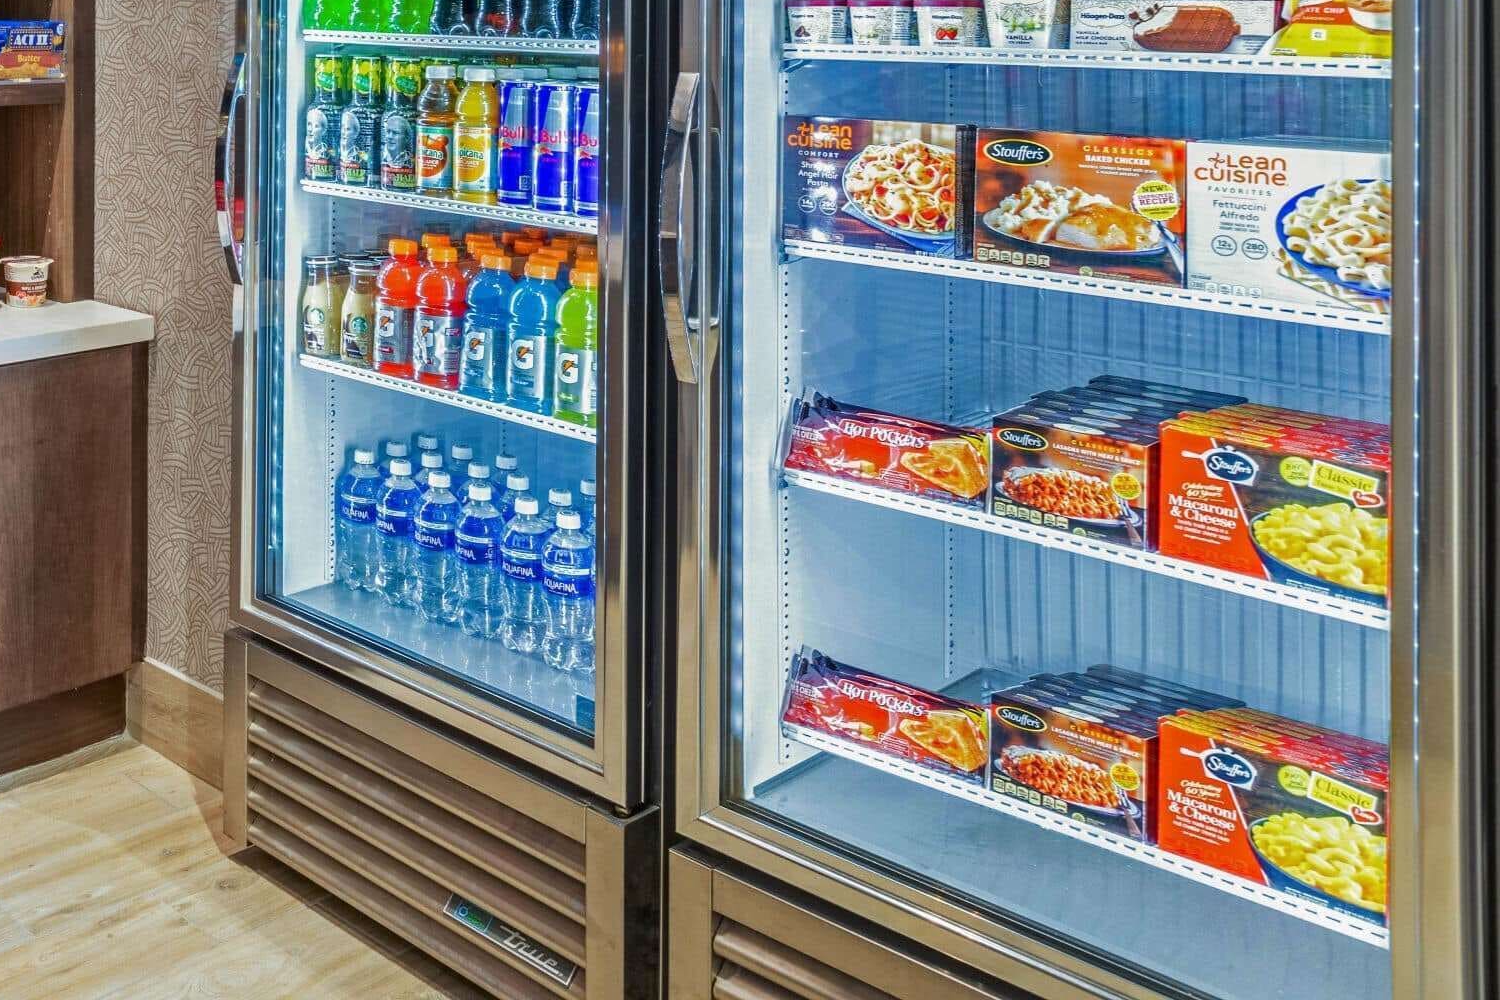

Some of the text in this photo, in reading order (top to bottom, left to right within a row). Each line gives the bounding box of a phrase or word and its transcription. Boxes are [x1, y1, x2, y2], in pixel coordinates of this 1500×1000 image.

[1323, 6, 1346, 16] CHIP
[13, 34, 32, 46] ACT
[1005, 34, 1034, 42] VANILLA
[17, 54, 41, 63] Butter
[798, 150, 839, 159] COMFORT
[991, 143, 1044, 162] Stouffer's
[1083, 144, 1155, 157] CLASSICS
[1085, 154, 1113, 164] BAKED
[1208, 186, 1273, 197] FAVORITES
[1139, 198, 1175, 206] RECIPE
[1213, 199, 1267, 212] Fettuccini
[1220, 210, 1260, 222] Alfredo
[1003, 429, 1042, 448] Stouffer's
[1316, 464, 1373, 492] Classic
[1168, 493, 1238, 519] Macaroni
[1169, 507, 1237, 530] & Cheese
[1315, 776, 1371, 811] Classic
[1166, 788, 1237, 821] Macaroni
[1168, 801, 1182, 814] &
[1182, 803, 1235, 832] Cheese
